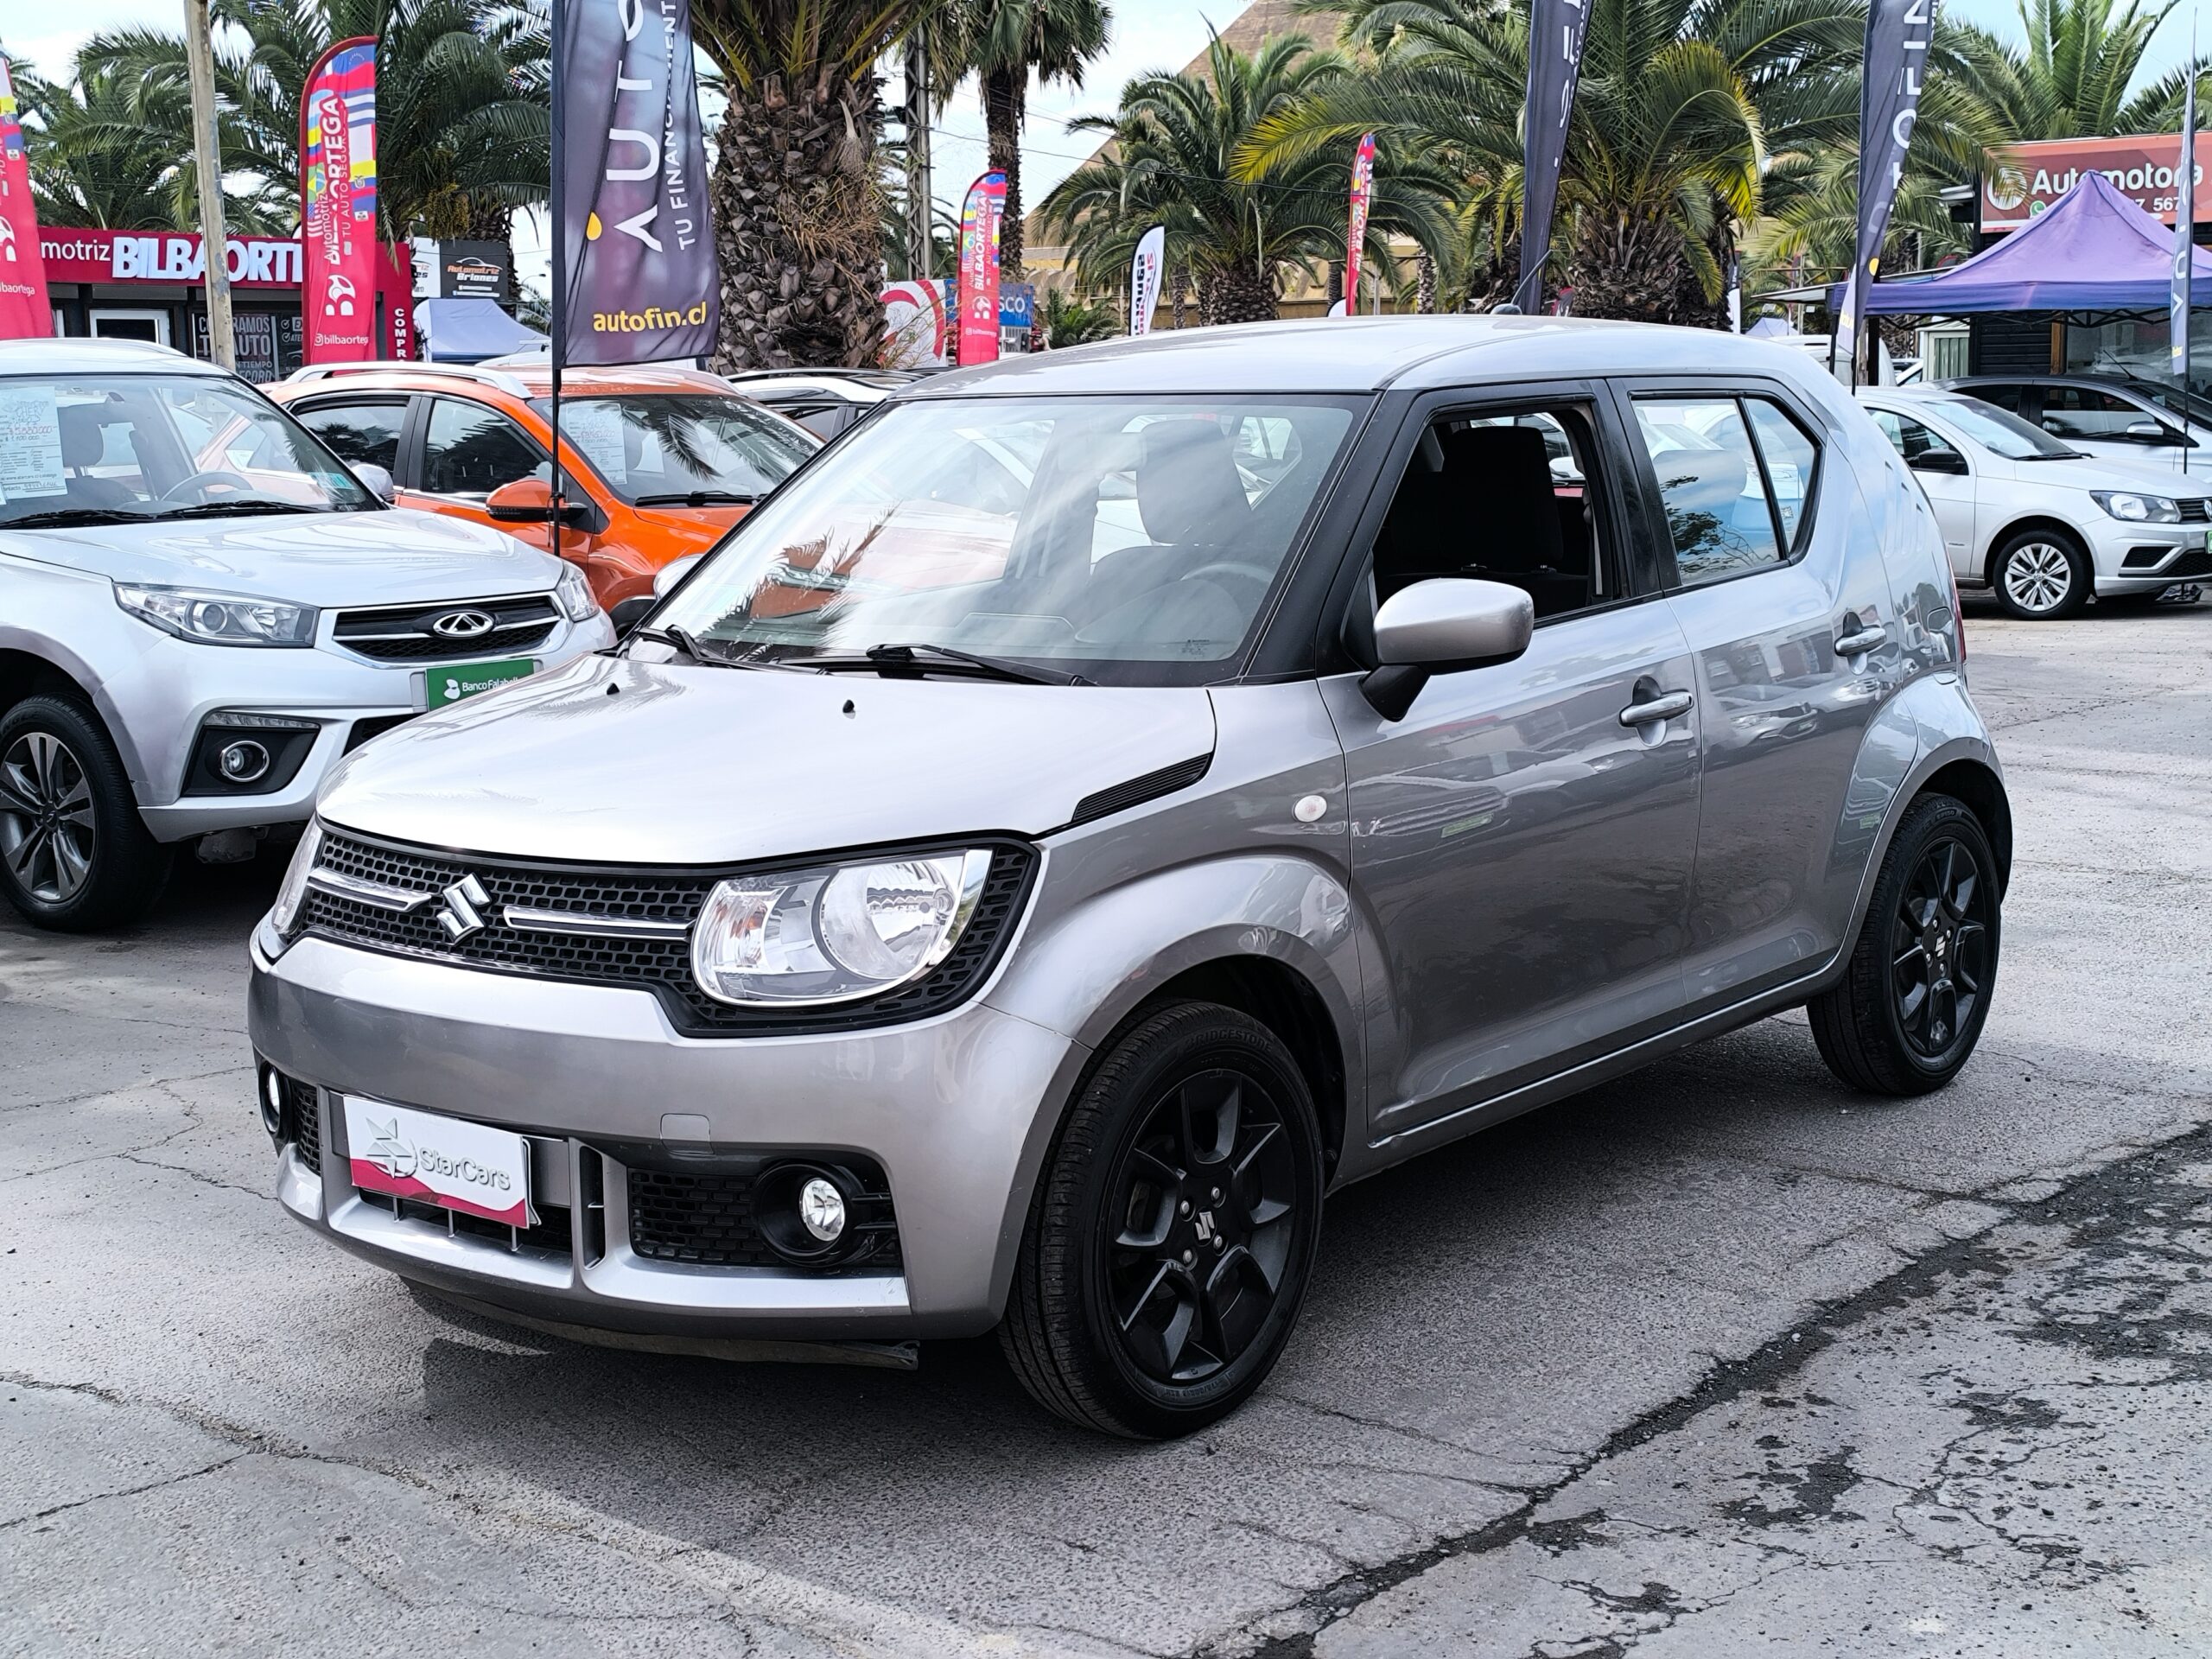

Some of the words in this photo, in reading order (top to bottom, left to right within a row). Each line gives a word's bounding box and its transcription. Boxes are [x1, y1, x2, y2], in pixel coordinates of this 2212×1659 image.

[2031, 162, 2203, 195] Autmotora
[340, 181, 350, 218] AUTO
[320, 194, 334, 263] Automotriz
[671, 216, 694, 251] TU
[974, 196, 988, 291] BILBAORTEGA
[41, 238, 111, 261] motriz
[112, 236, 302, 283] BILBAORT
[448, 264, 499, 275] Automotriz
[456, 272, 499, 283] Briones
[199, 316, 270, 334] CRAMOS
[394, 308, 407, 362] COMPR
[593, 301, 707, 334] autofin.cl
[462, 682, 487, 692] Banco
[419, 1147, 512, 1191] StarCars
